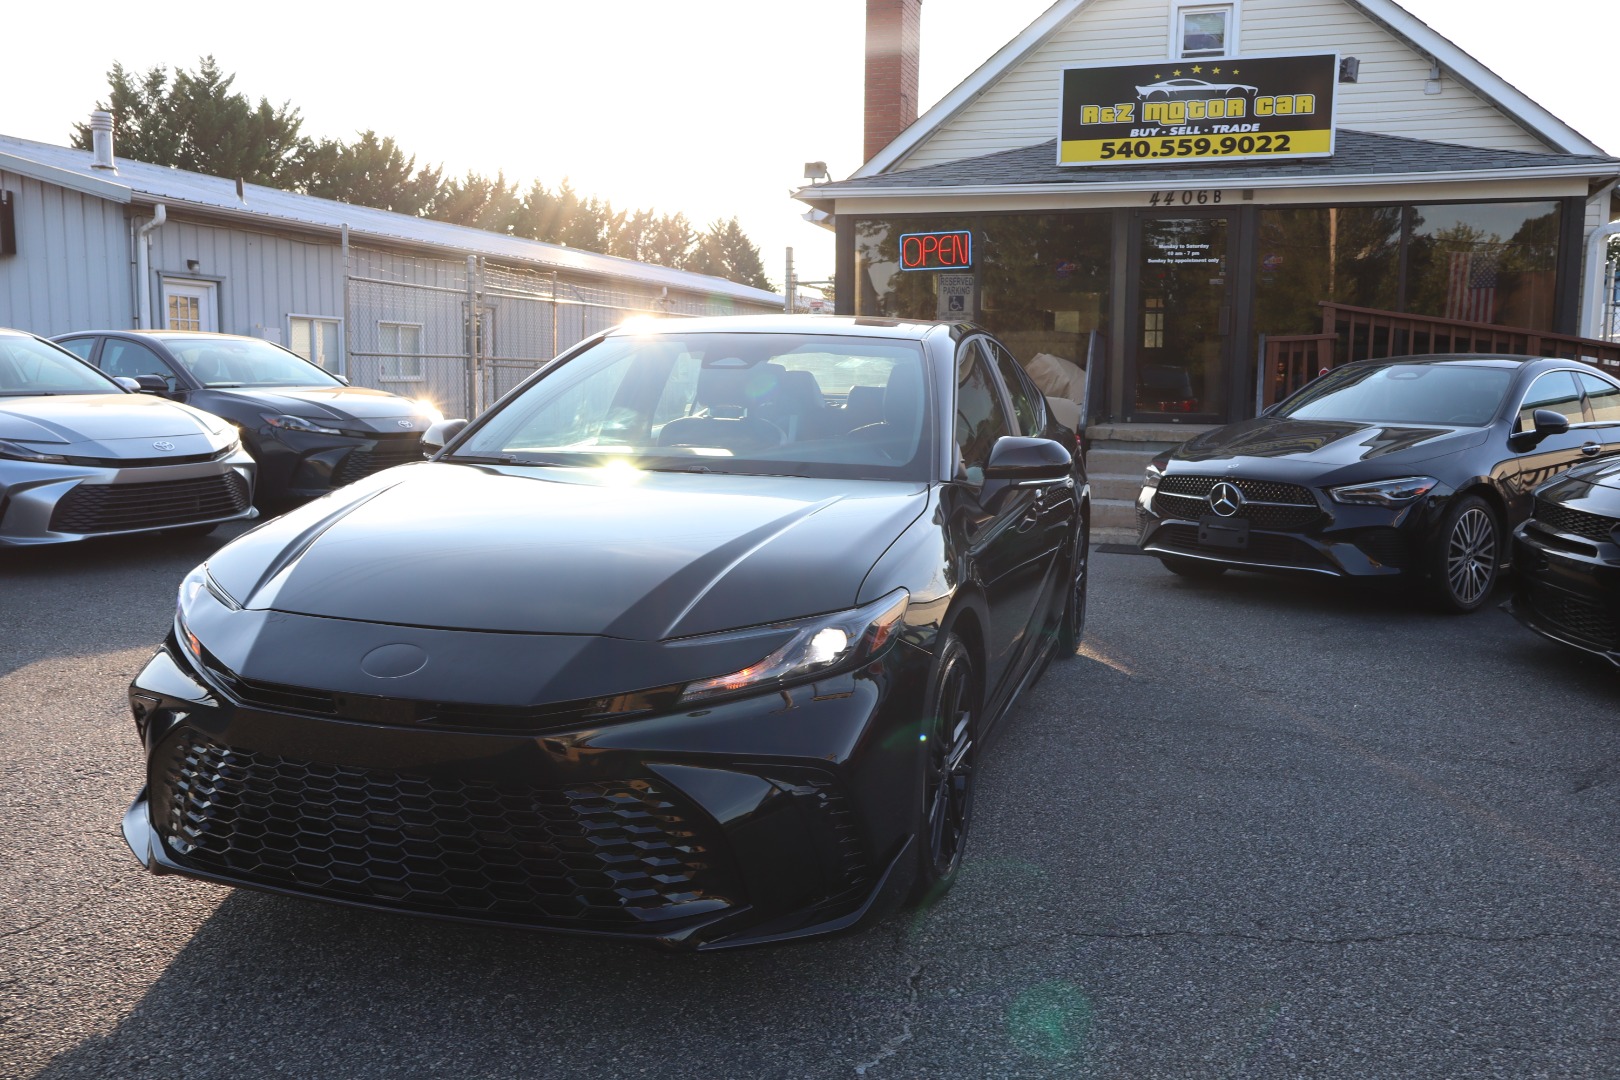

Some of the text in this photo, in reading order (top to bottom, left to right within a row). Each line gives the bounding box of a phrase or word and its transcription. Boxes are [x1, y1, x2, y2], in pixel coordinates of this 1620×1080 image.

[1130, 123, 1260, 137] BUY SELL TRADE
[1100, 134, 1290, 159] 540.559.9022
[903, 234, 968, 267] OPEN
[940, 277, 973, 286] RESERVED
[943, 287, 970, 295] PARKING
